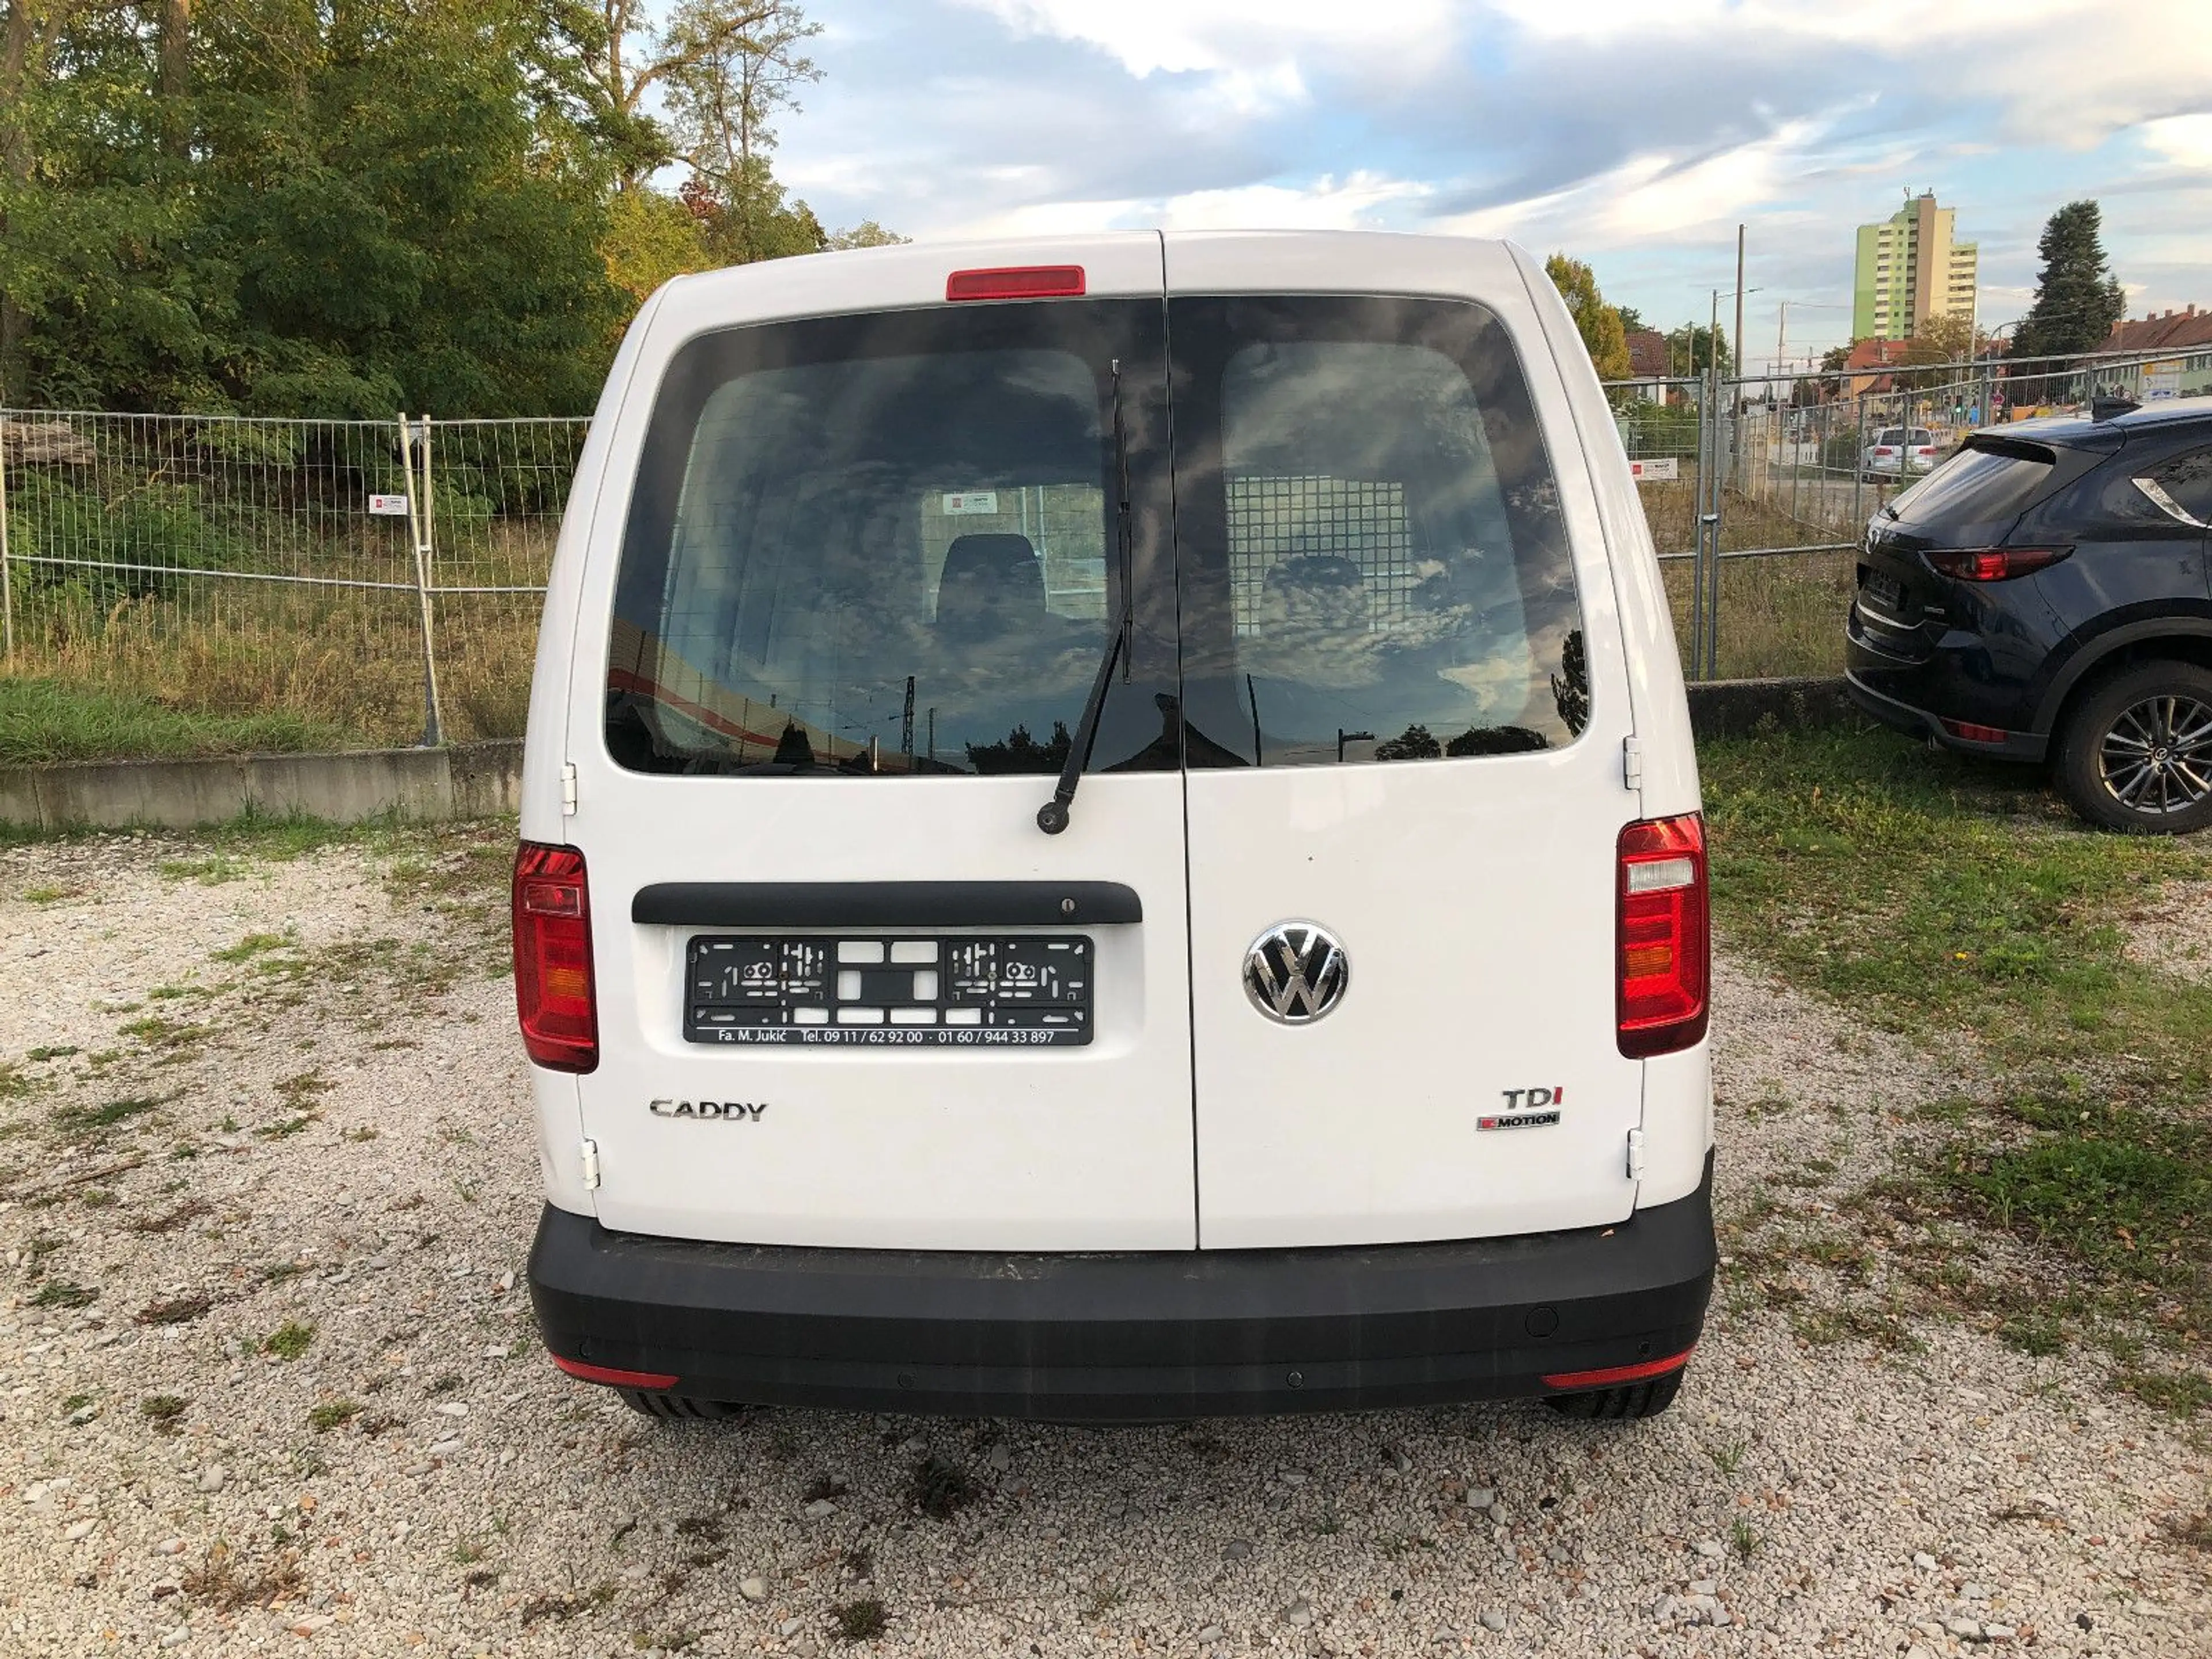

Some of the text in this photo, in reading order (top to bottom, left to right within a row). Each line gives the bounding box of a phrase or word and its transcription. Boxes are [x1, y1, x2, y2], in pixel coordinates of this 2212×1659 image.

[718, 1030, 734, 1040] Fa.
[738, 1030, 752, 1041] M.
[755, 1029, 787, 1041] Jukić
[800, 1030, 821, 1041] Tel.
[824, 1031, 840, 1042] 09
[844, 1031, 857, 1042] 11
[869, 1031, 885, 1043] 62
[938, 1031, 952, 1043] 01
[957, 1031, 973, 1043] 60
[984, 1031, 1007, 1043] 944
[1012, 1031, 1027, 1043] 33
[1031, 1031, 1054, 1043] 897
[1502, 1086, 1563, 1109] TDI
[650, 1099, 768, 1122] CADDY
